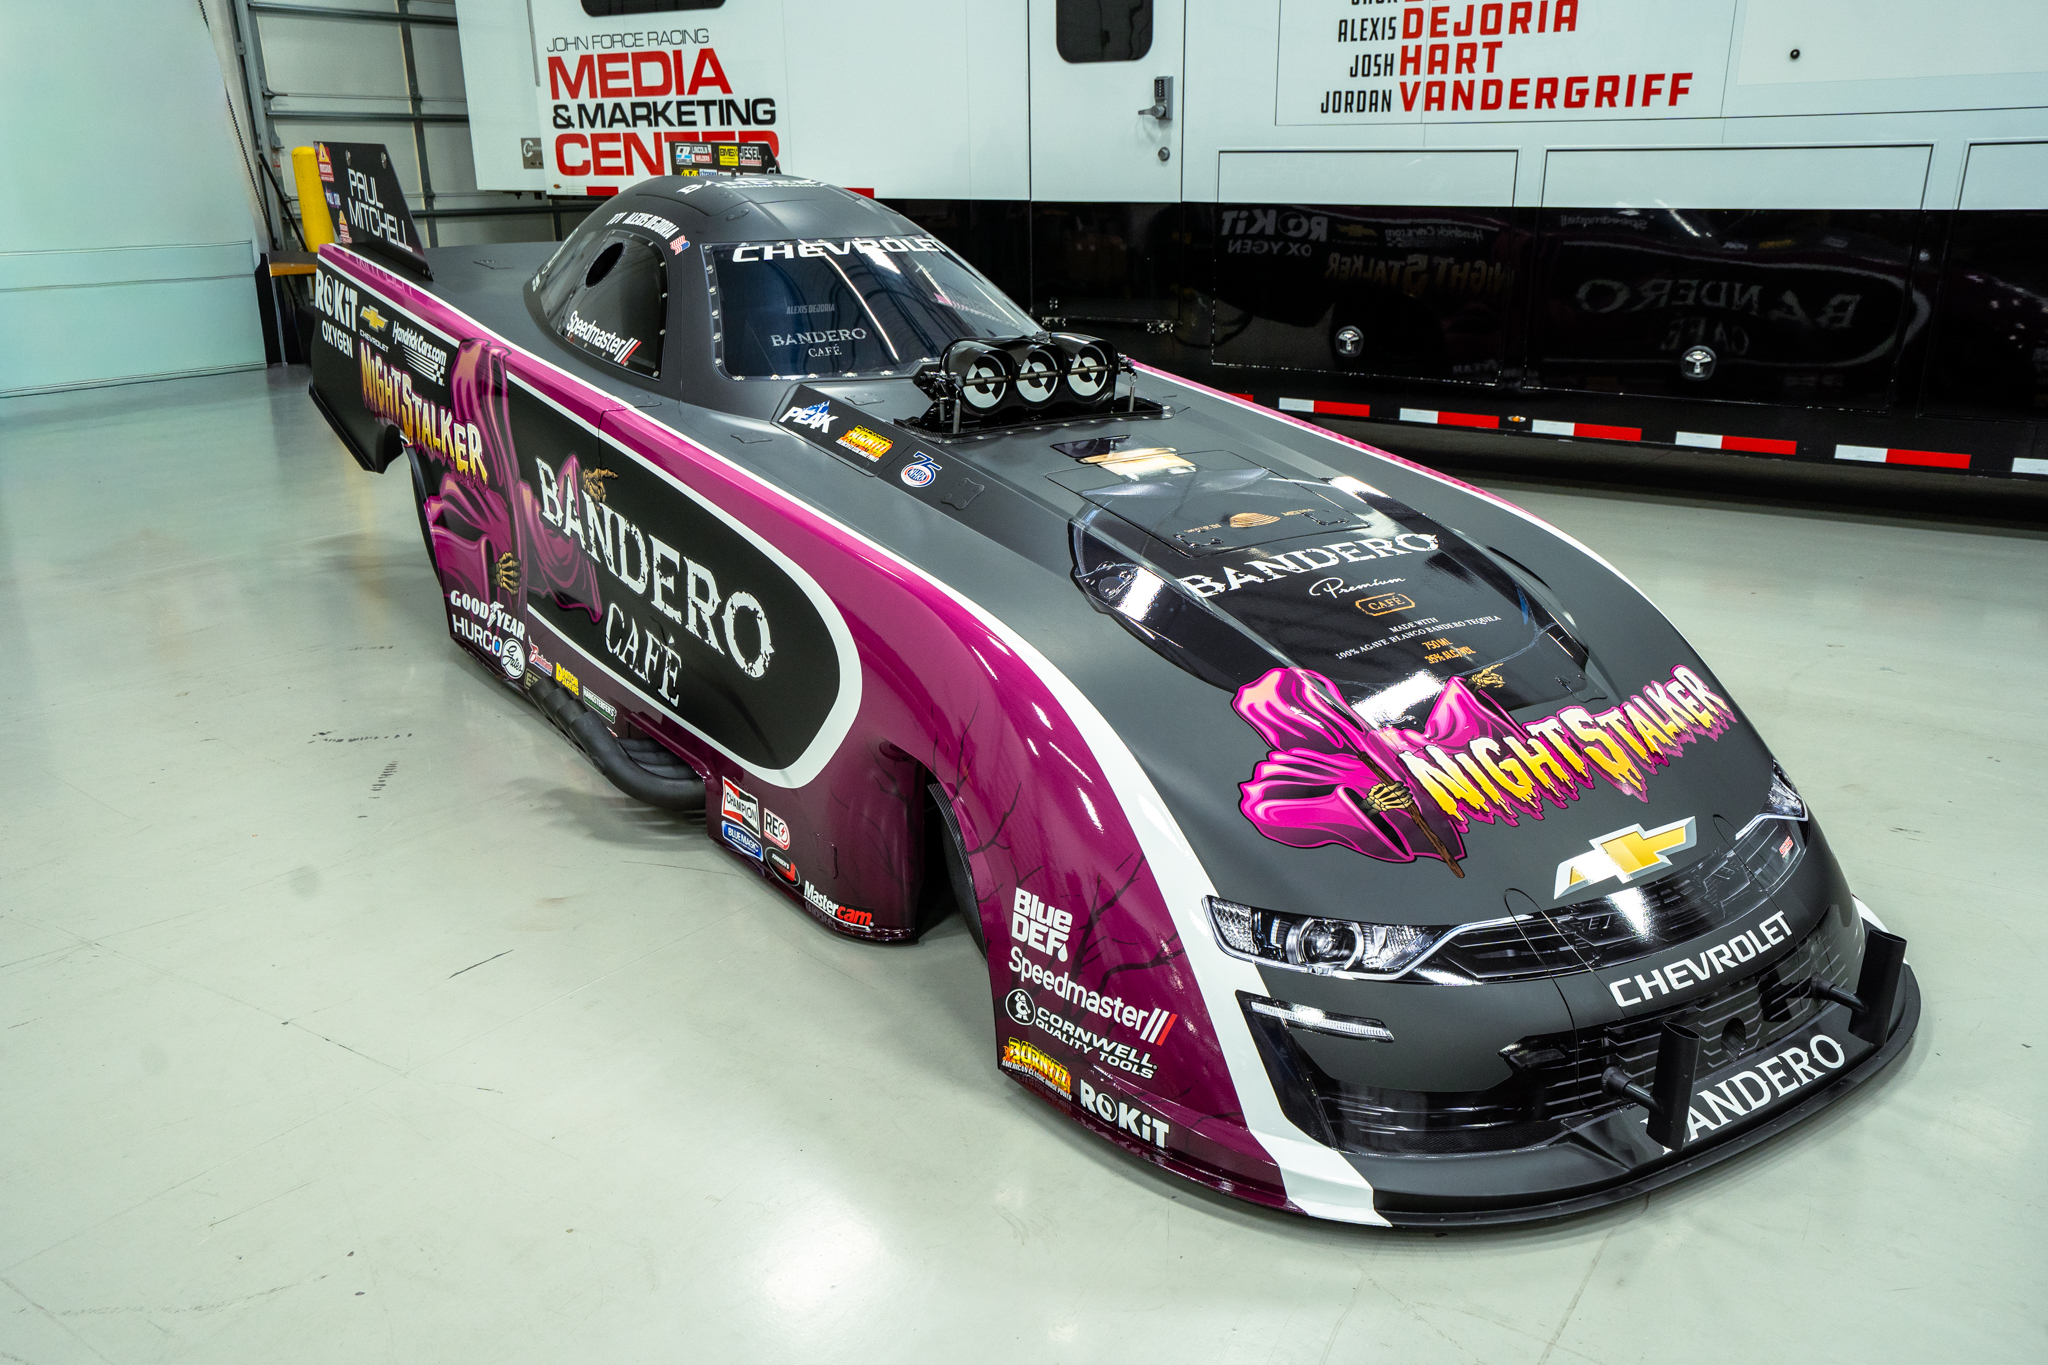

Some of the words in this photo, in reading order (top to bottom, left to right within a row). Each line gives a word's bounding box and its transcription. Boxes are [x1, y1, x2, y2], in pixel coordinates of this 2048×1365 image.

[547, 36, 589, 53] JOHN
[592, 32, 644, 51] FORCE
[647, 28, 710, 46] RACING
[1338, 16, 1397, 42] ALEXIS
[1402, 0, 1578, 40] DEJORIA
[547, 48, 734, 100] MEDIA
[1349, 52, 1395, 78] JOSH
[1400, 40, 1503, 76] HART
[552, 104, 575, 129] &
[577, 98, 777, 129] MARKETING
[1320, 89, 1392, 114] JORDAN
[1400, 72, 1694, 112] VANDERGRIFF
[347, 167, 384, 209] PAUL
[347, 197, 413, 253] MITCHELL
[786, 304, 808, 315] ALEXIS
[808, 303, 835, 313] DEJORIA
[321, 320, 354, 359] OXYGEN
[359, 328, 390, 353] CHEVROLET
[566, 310, 626, 355] Speedmaster
[770, 327, 867, 347] BANDERO
[808, 343, 842, 357] CAFÉ
[778, 405, 840, 434] PEAK
[536, 457, 775, 678] BANDERO
[1175, 532, 1440, 598] BANDERO
[1308, 576, 1406, 600] Premium
[1368, 595, 1406, 611] CAFÉ
[452, 613, 503, 658] HURCO
[1335, 648, 1360, 660] 100%
[1359, 638, 1390, 653] AGAVE
[1388, 628, 1427, 643] BLANCO
[1424, 620, 1466, 633] BANDERO
[1464, 615, 1502, 626] TEQUILA
[1388, 621, 1417, 633] MADE
[1414, 616, 1439, 626] WITH
[1421, 638, 1440, 651] 750
[1436, 637, 1454, 647] ML
[605, 602, 683, 708] CAFÉ
[726, 792, 757, 823] CHAMPION
[741, 833, 759, 853] MAGIC
[803, 880, 873, 926] Mastercam
[1013, 887, 1073, 931] Blue
[1011, 911, 1070, 957] DEF
[1608, 910, 1794, 1008] CHEVROLET
[1009, 946, 1149, 1031] Speedmaster
[1035, 1018, 1094, 1055] QUALITY
[1098, 1051, 1155, 1079] TOOLS
[1037, 1006, 1154, 1068] CORNWELL
[1640, 1034, 1846, 1156] ANDERO
